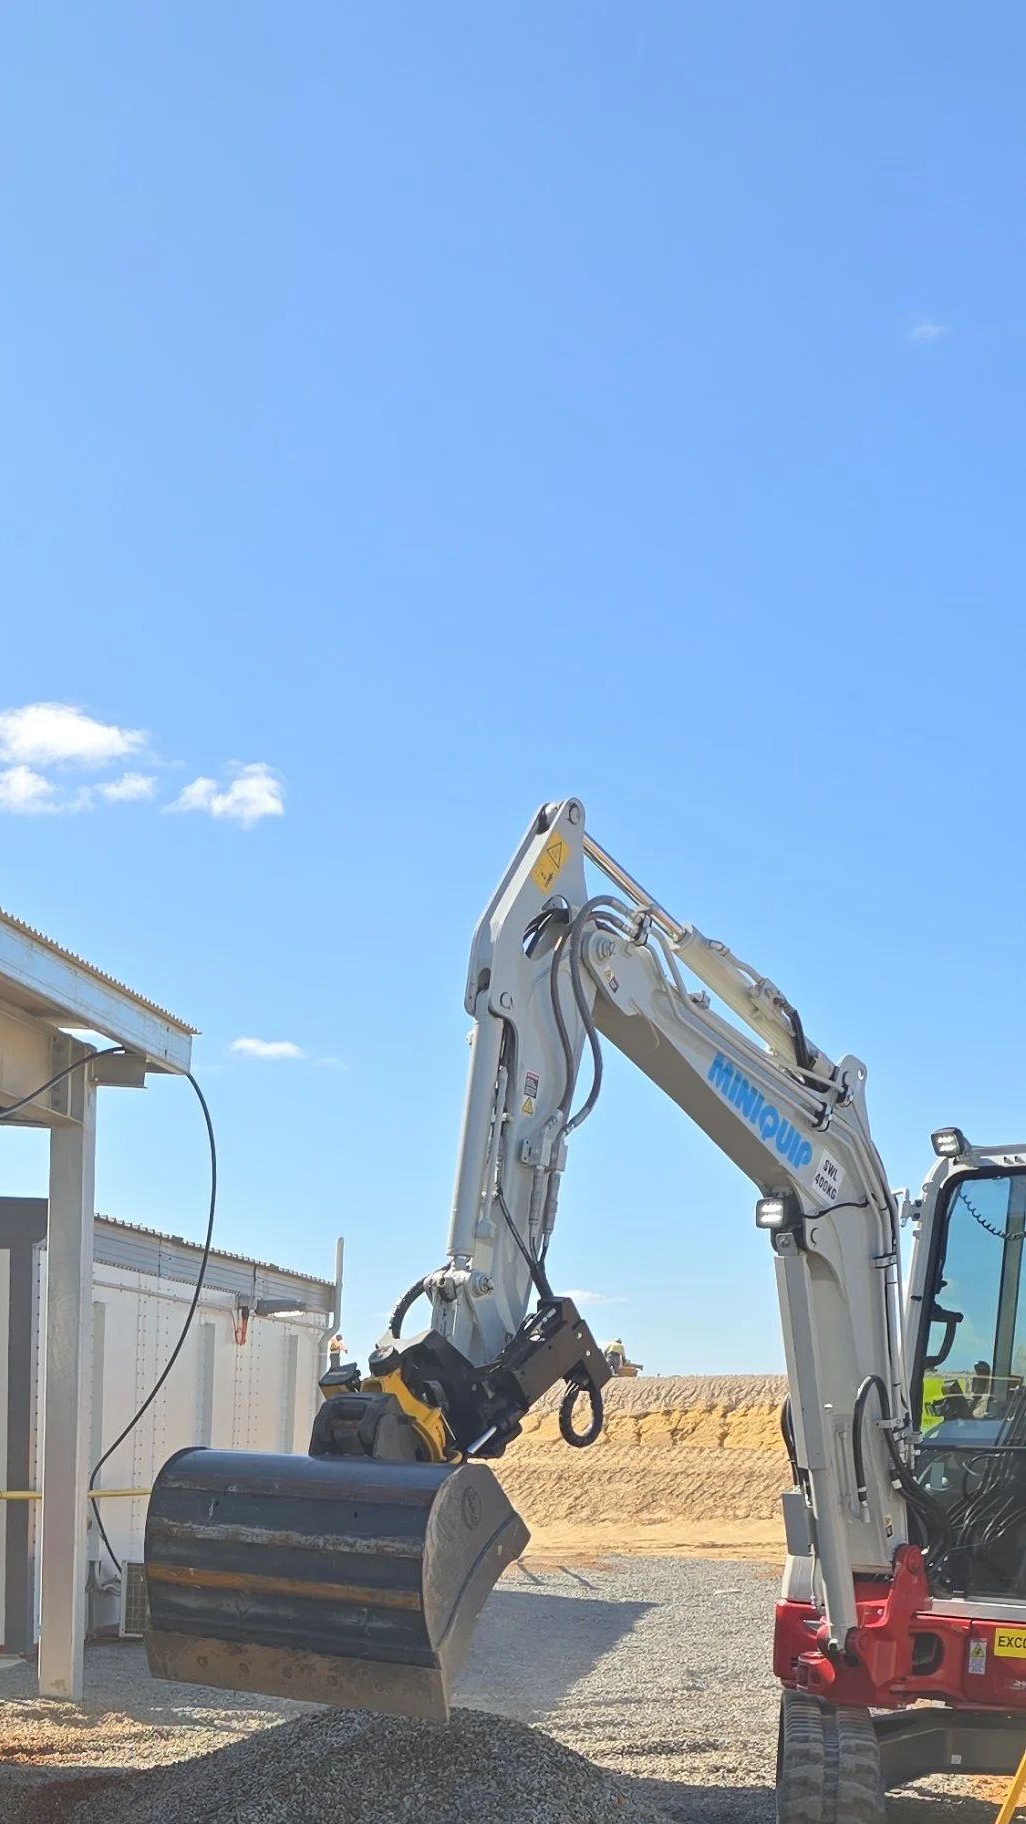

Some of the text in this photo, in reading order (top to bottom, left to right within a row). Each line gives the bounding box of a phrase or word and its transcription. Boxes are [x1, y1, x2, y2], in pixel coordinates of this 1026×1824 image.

[707, 1051, 813, 1170] MINIQUIP
[823, 1159, 839, 1182] SWL
[814, 1173, 837, 1200] 400KG
